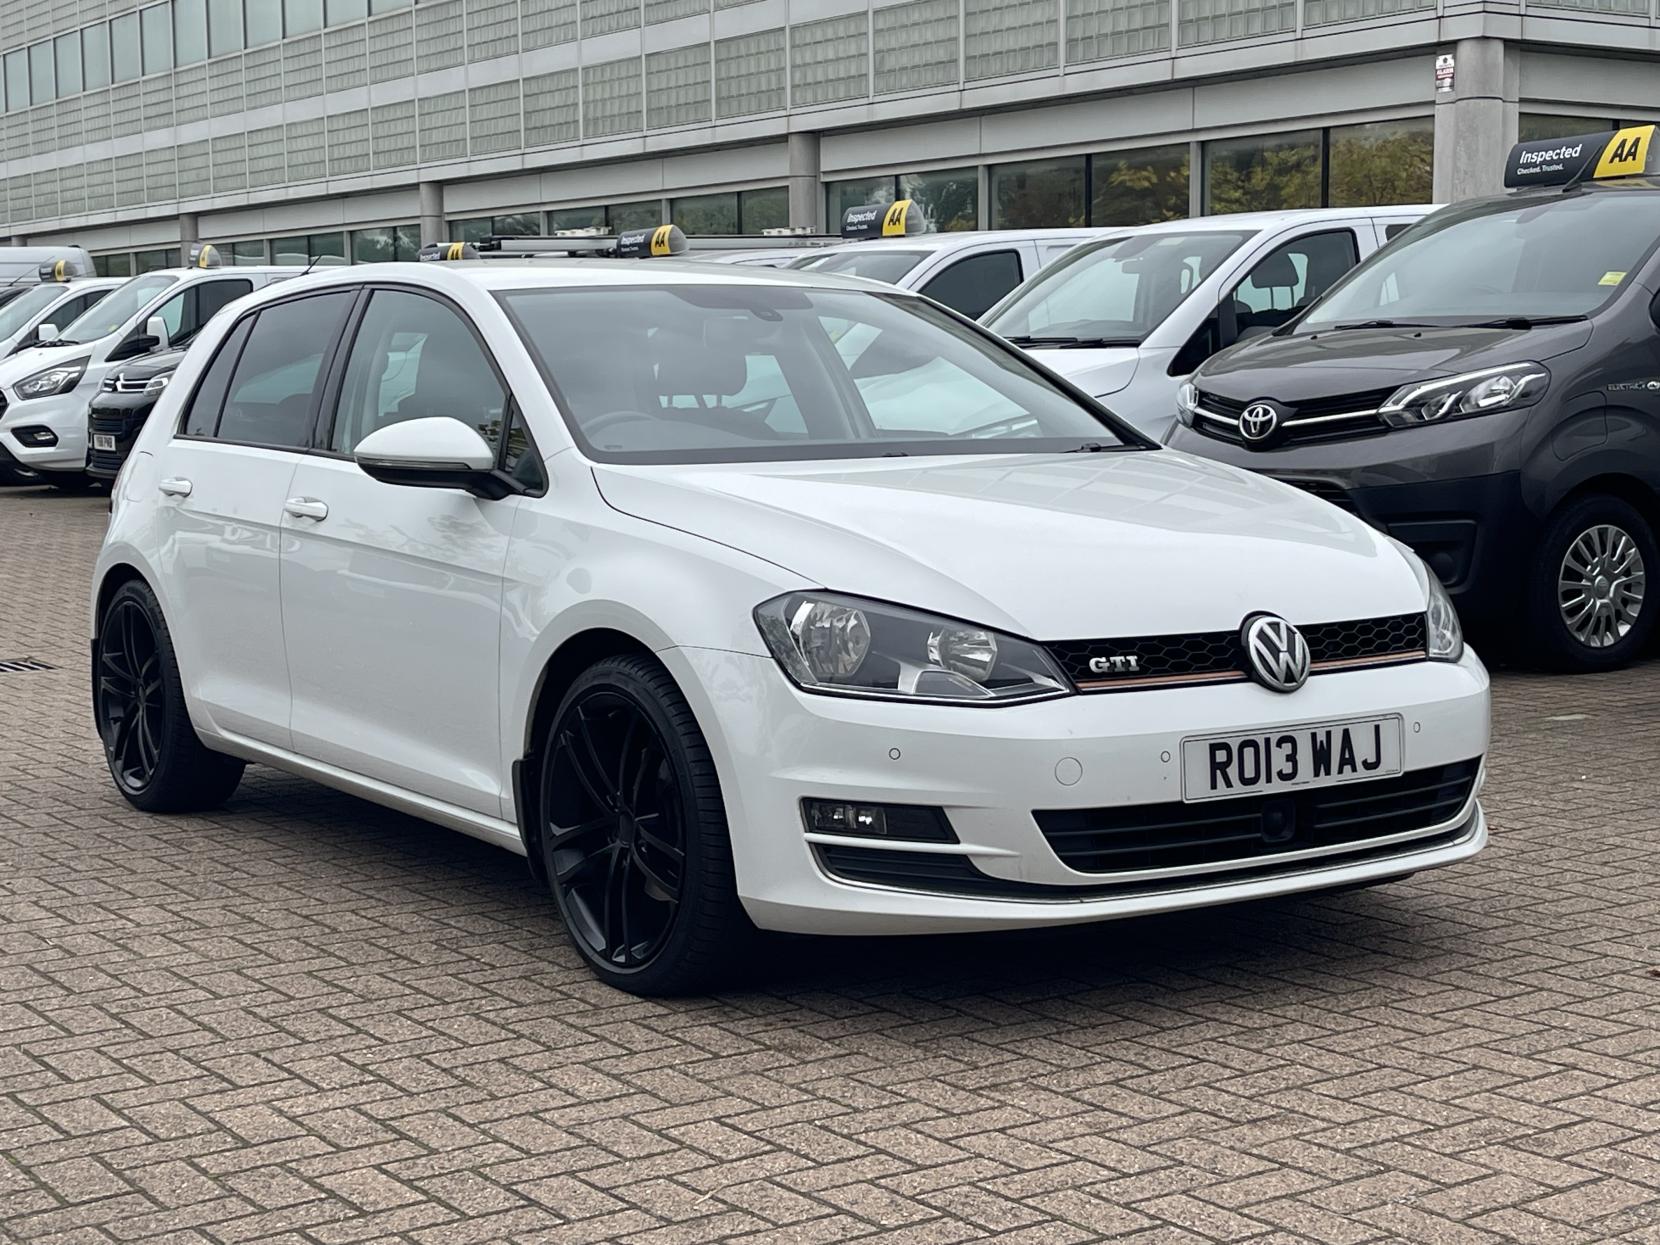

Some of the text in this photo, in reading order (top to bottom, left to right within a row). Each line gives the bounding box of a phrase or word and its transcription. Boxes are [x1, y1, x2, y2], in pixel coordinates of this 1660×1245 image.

[1519, 143, 1583, 165] Inspected
[1609, 137, 1641, 164] AA
[1517, 163, 1564, 175] Checked. Trusted.
[847, 210, 877, 223] Inspected
[888, 207, 904, 227] AA
[655, 231, 666, 248] AA
[1089, 655, 1139, 673] GTI
[1209, 724, 1381, 790] RO13 WAJ
